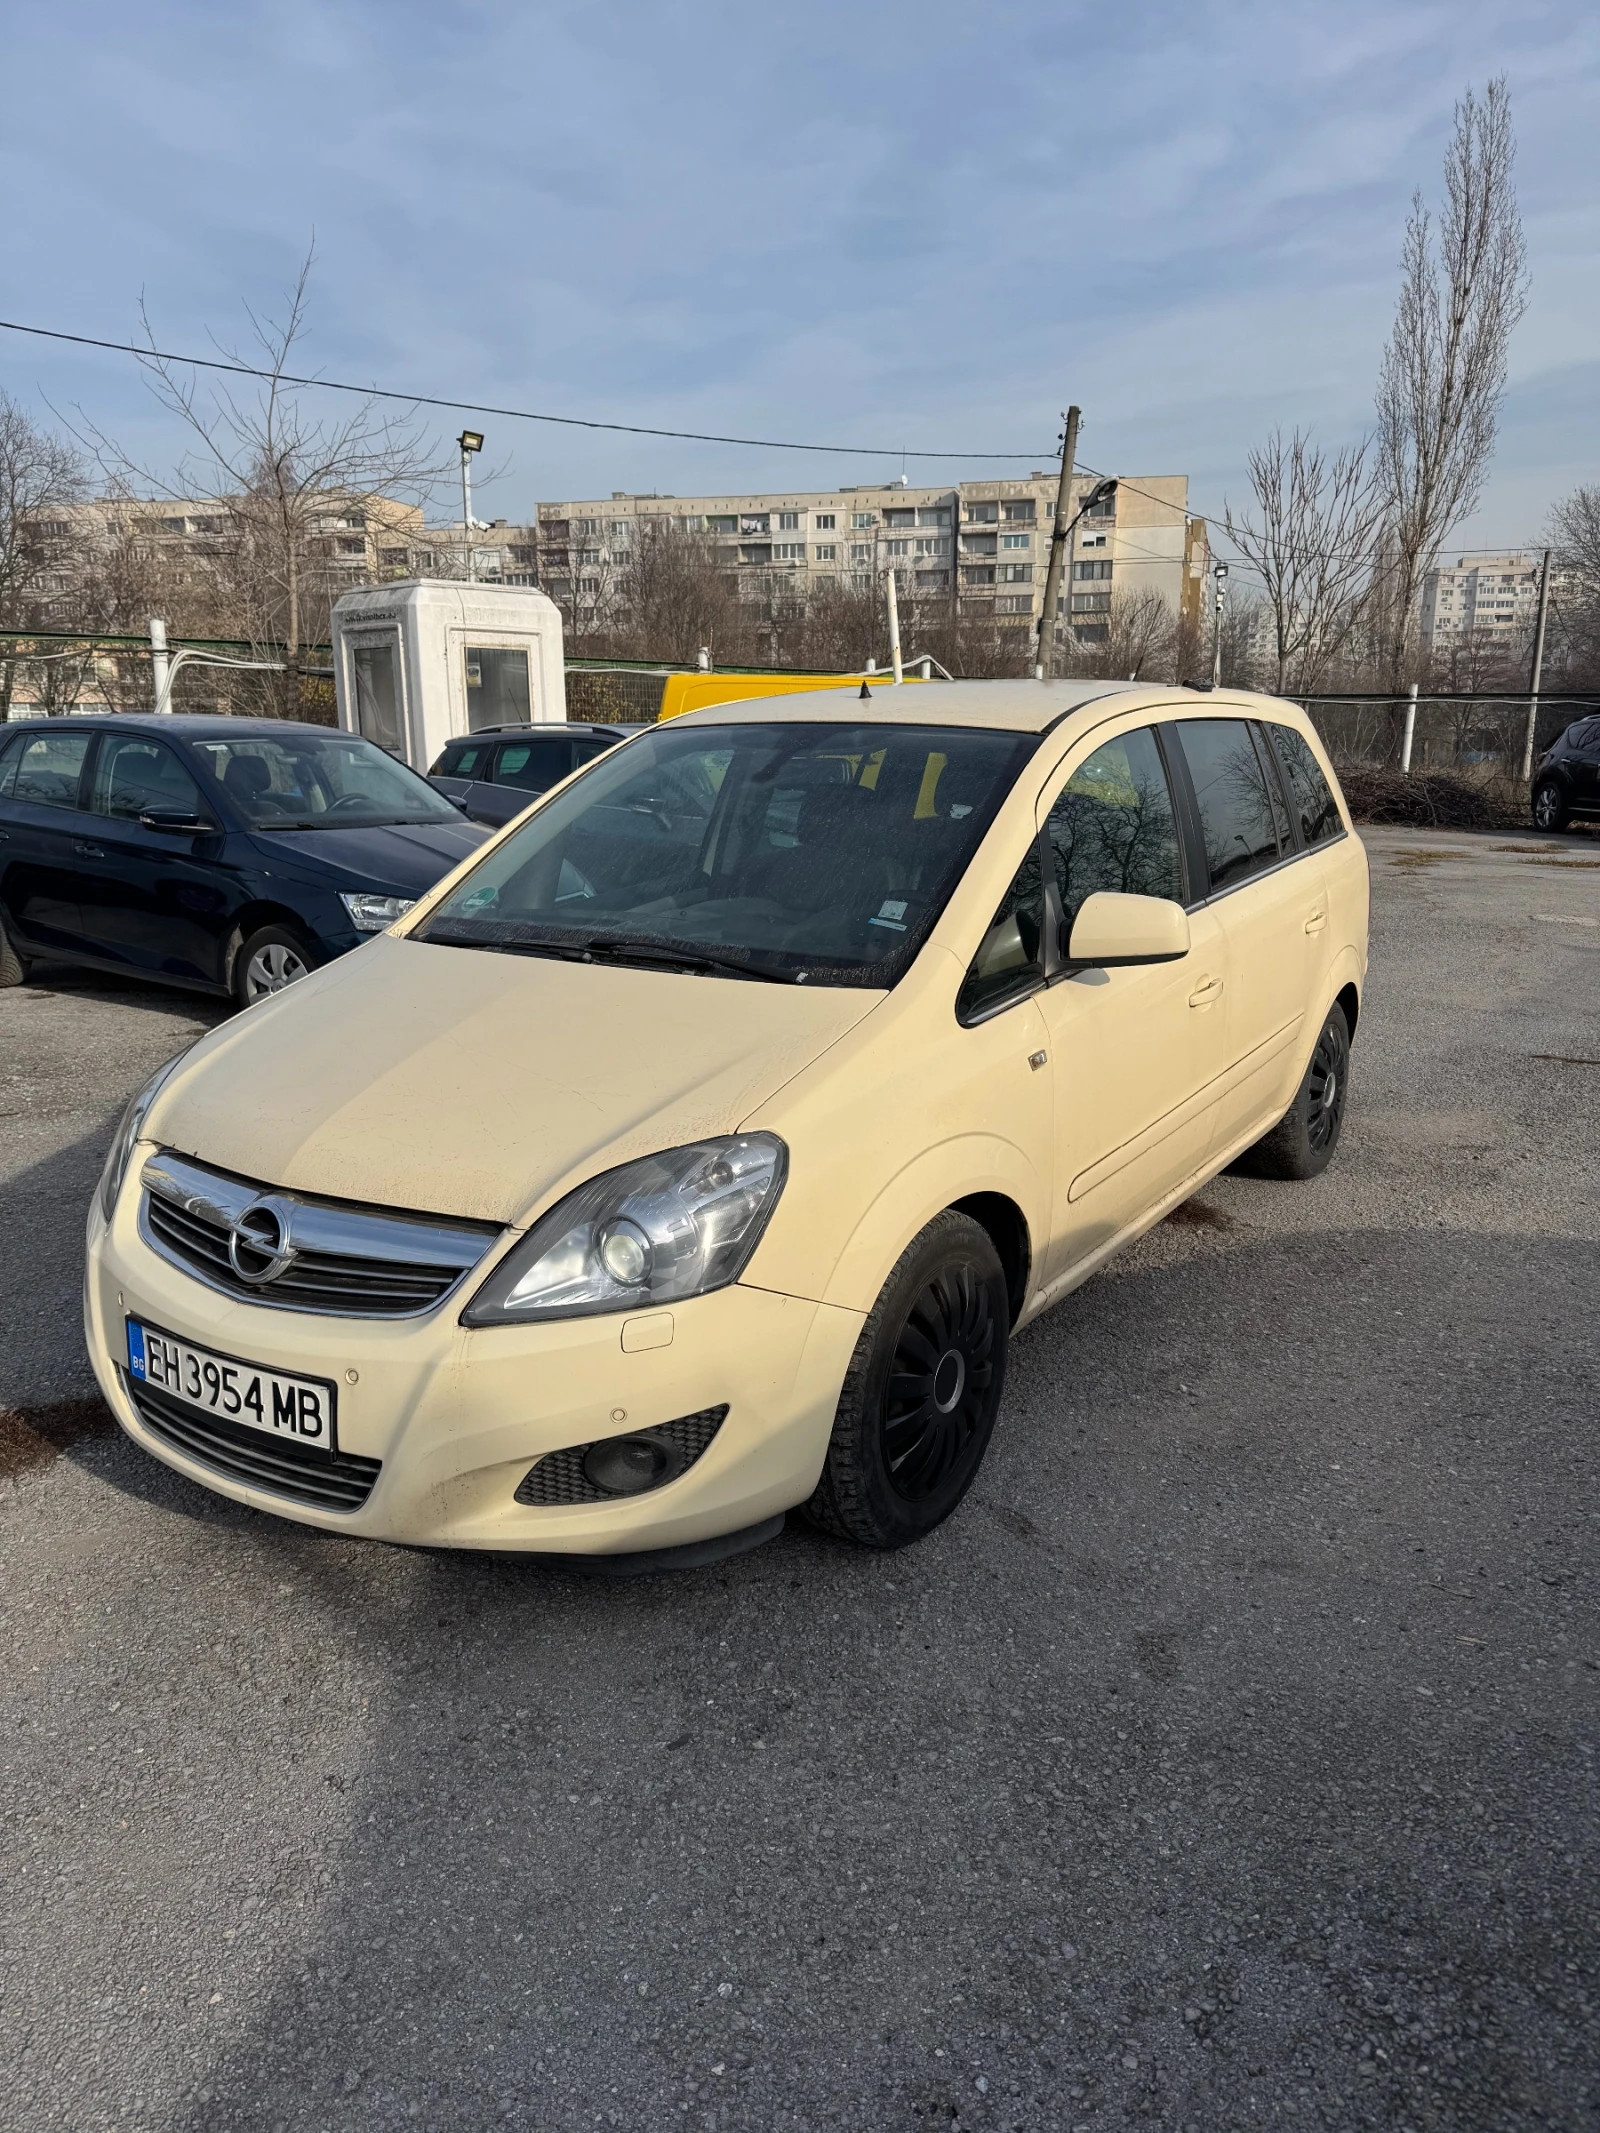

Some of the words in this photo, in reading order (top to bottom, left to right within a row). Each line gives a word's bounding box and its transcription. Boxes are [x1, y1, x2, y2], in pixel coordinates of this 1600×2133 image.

[132, 1355, 145, 1372] BG
[146, 1333, 182, 1392] EH
[186, 1353, 265, 1424] 3954
[272, 1380, 324, 1438] MB
